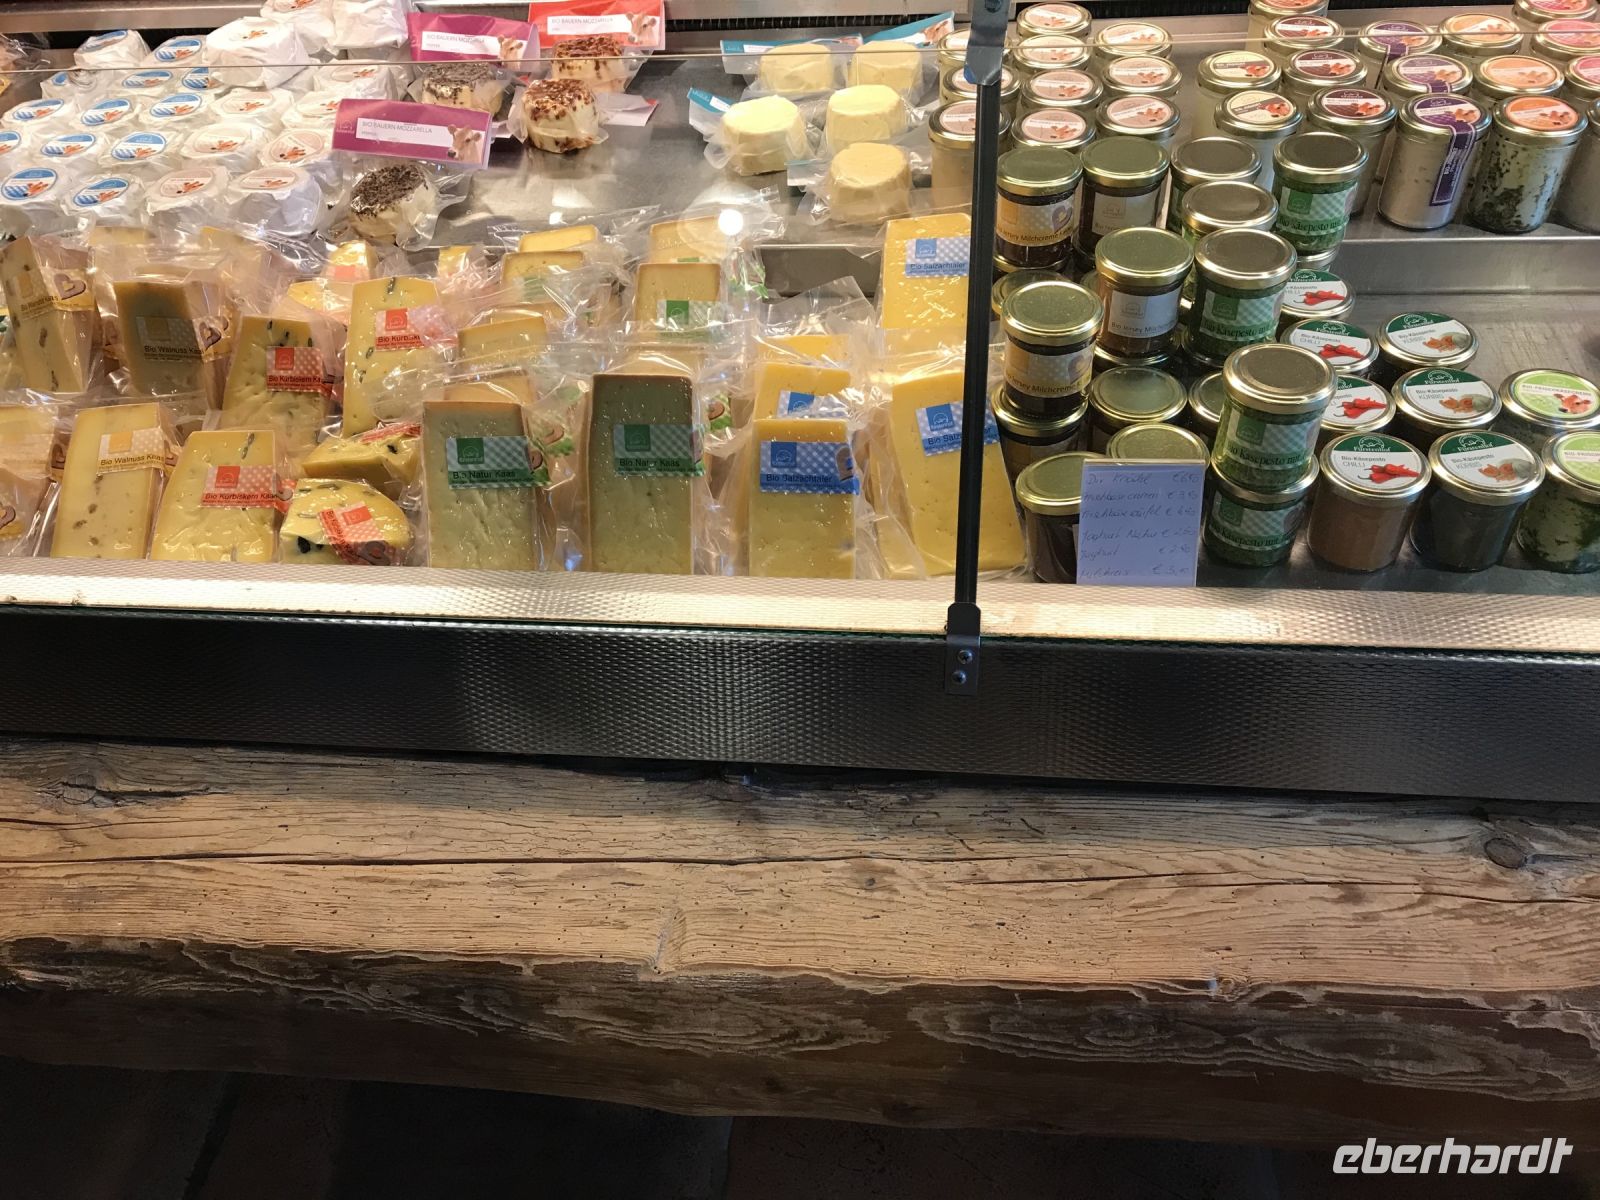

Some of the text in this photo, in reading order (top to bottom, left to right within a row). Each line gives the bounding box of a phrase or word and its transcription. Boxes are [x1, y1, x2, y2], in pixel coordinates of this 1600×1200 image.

[373, 122, 396, 131] BAUERN
[396, 124, 433, 134] MOZZARELLA
[144, 345, 156, 353] Bio
[928, 436, 941, 445] Bio
[114, 455, 145, 464] Walnuss
[619, 459, 633, 467] Bio
[453, 471, 467, 480] Bio
[469, 471, 492, 479] Natur
[766, 474, 780, 482] Bio
